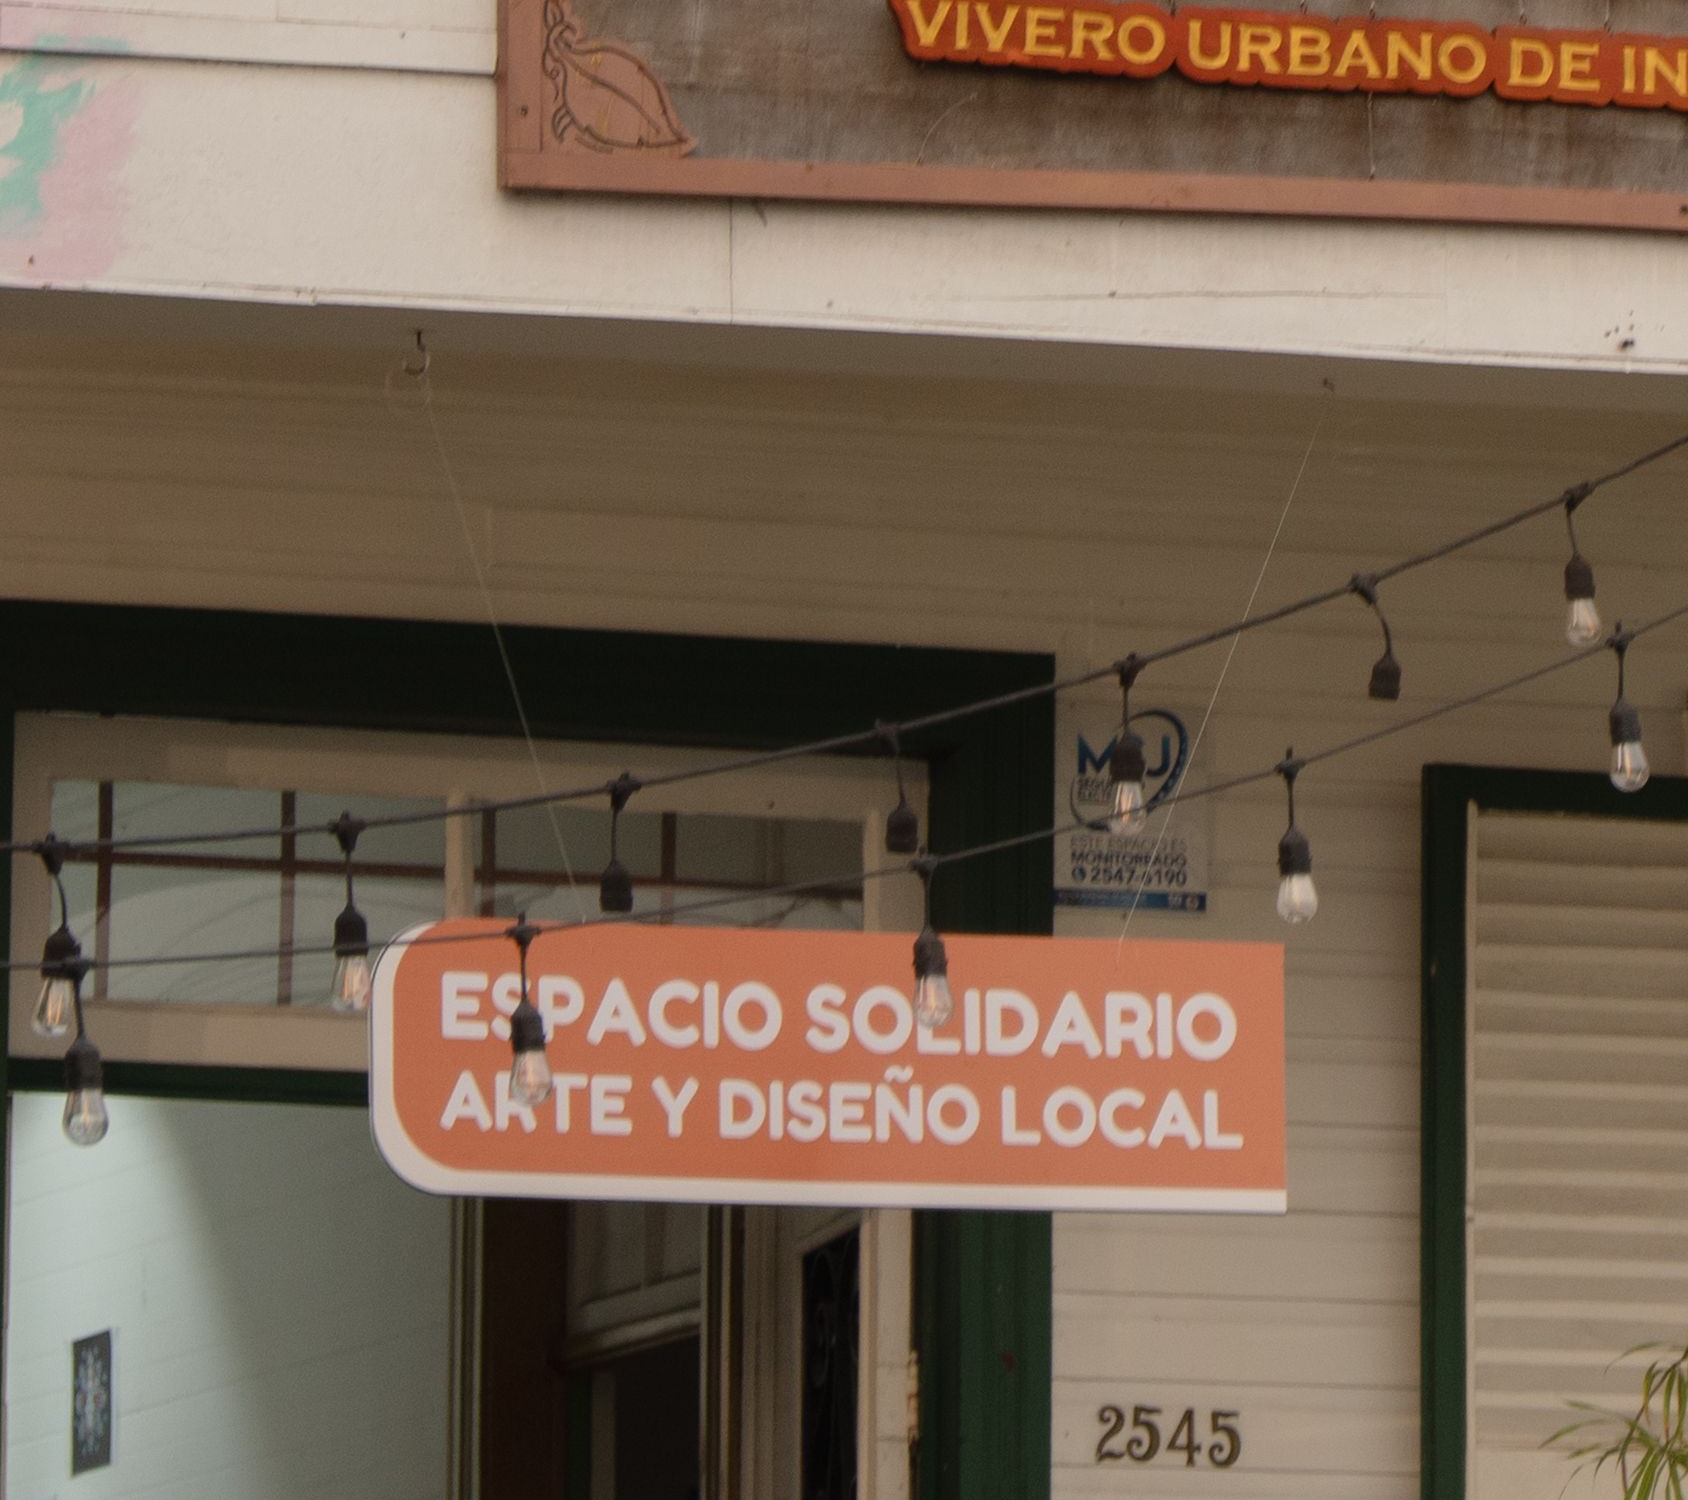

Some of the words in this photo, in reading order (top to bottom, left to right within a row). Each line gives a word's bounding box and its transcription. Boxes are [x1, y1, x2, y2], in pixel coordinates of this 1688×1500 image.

[1187, 17, 1488, 85] URBANO
[1506, 36, 1601, 92] DE
[441, 971, 783, 1051] ESPACIO
[804, 982, 1239, 1062] SOLIDARIO
[439, 1069, 633, 1136] ARTE
[651, 1075, 700, 1139] Y
[718, 1064, 981, 1146] DISEÑO
[1001, 1085, 1245, 1150] LOCAL
[1095, 1404, 1242, 1468] 2545
